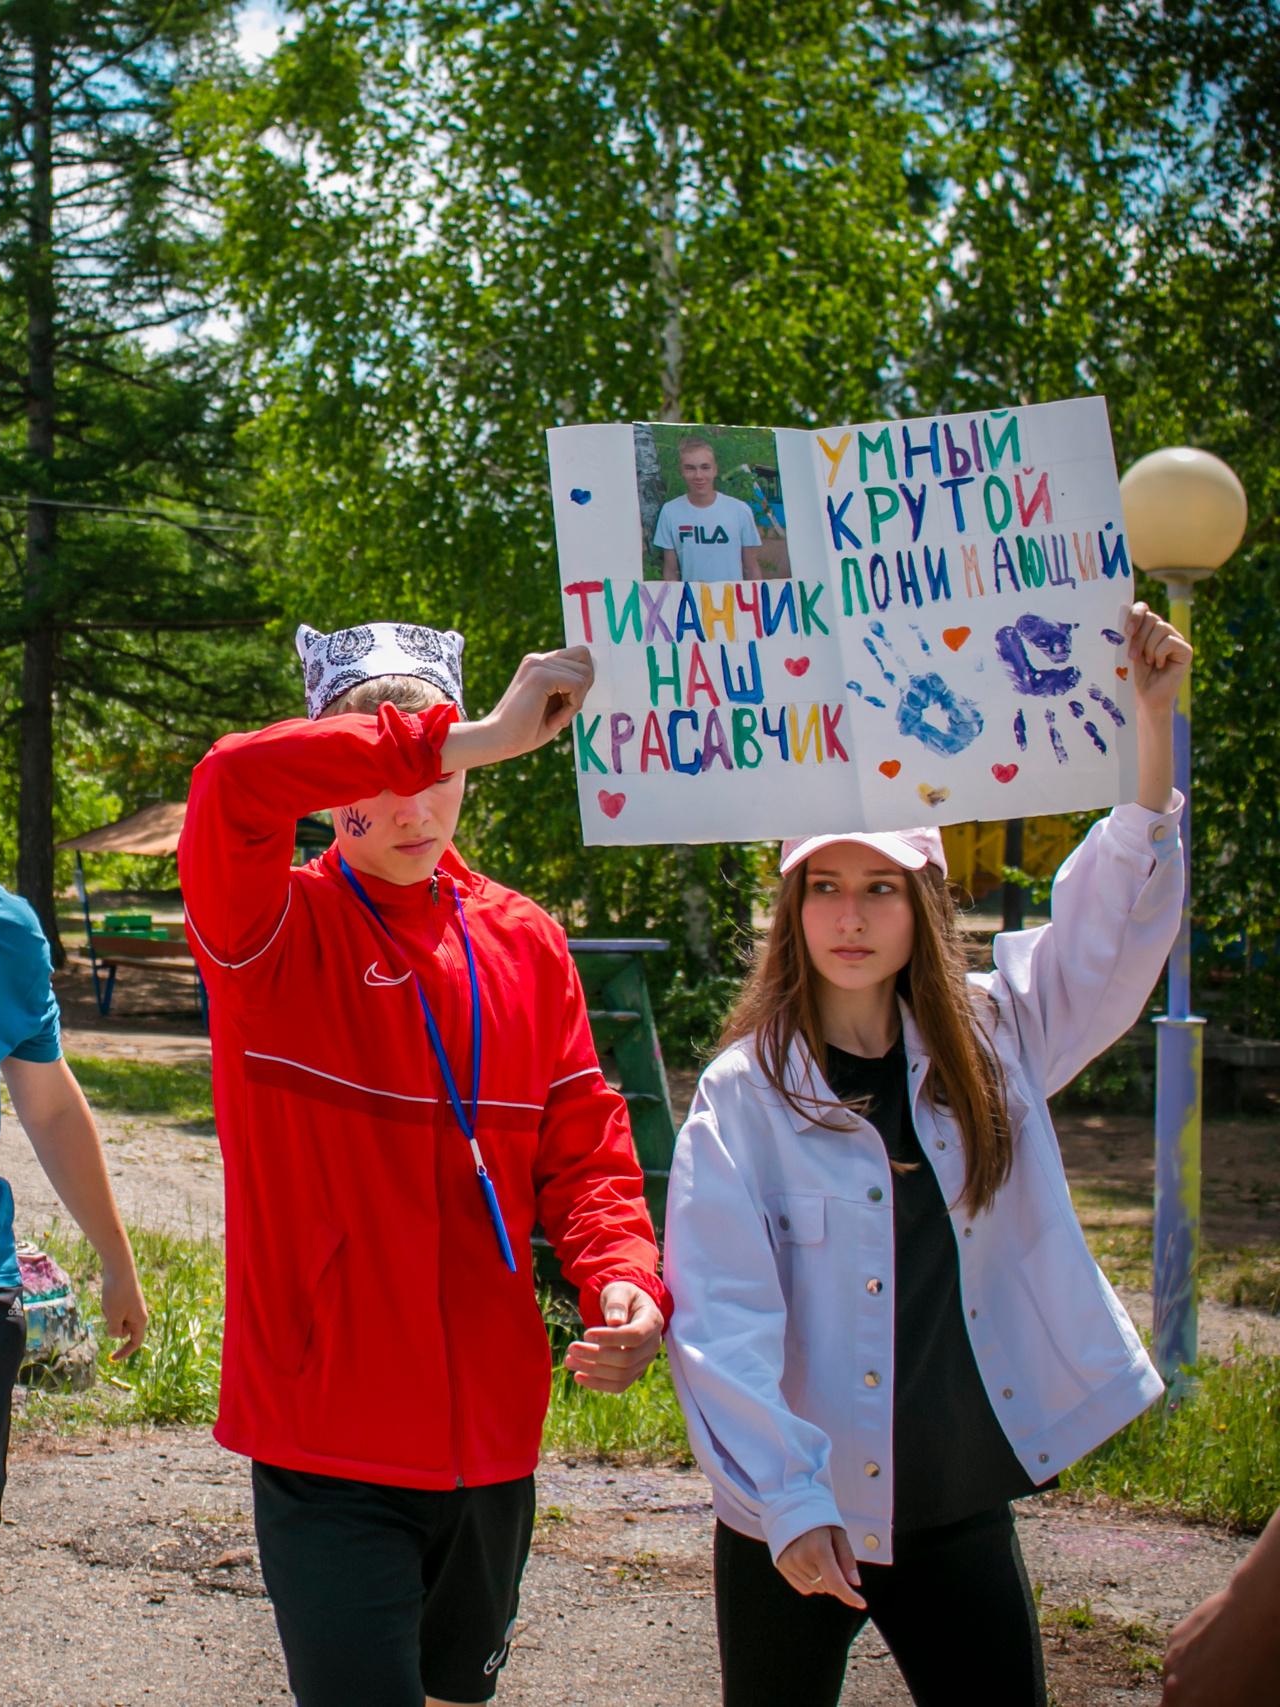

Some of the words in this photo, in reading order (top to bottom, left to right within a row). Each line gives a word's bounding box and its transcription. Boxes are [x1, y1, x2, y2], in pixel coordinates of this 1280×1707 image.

[816, 410, 1021, 487] УМНЫЙ
[678, 526, 729, 544] FILA
[826, 467, 1053, 551] КРУТОЙ
[564, 578, 830, 643] ТИХАНЧИК
[645, 641, 765, 707] НАШ
[576, 701, 851, 775] КРАСАВЧИК
